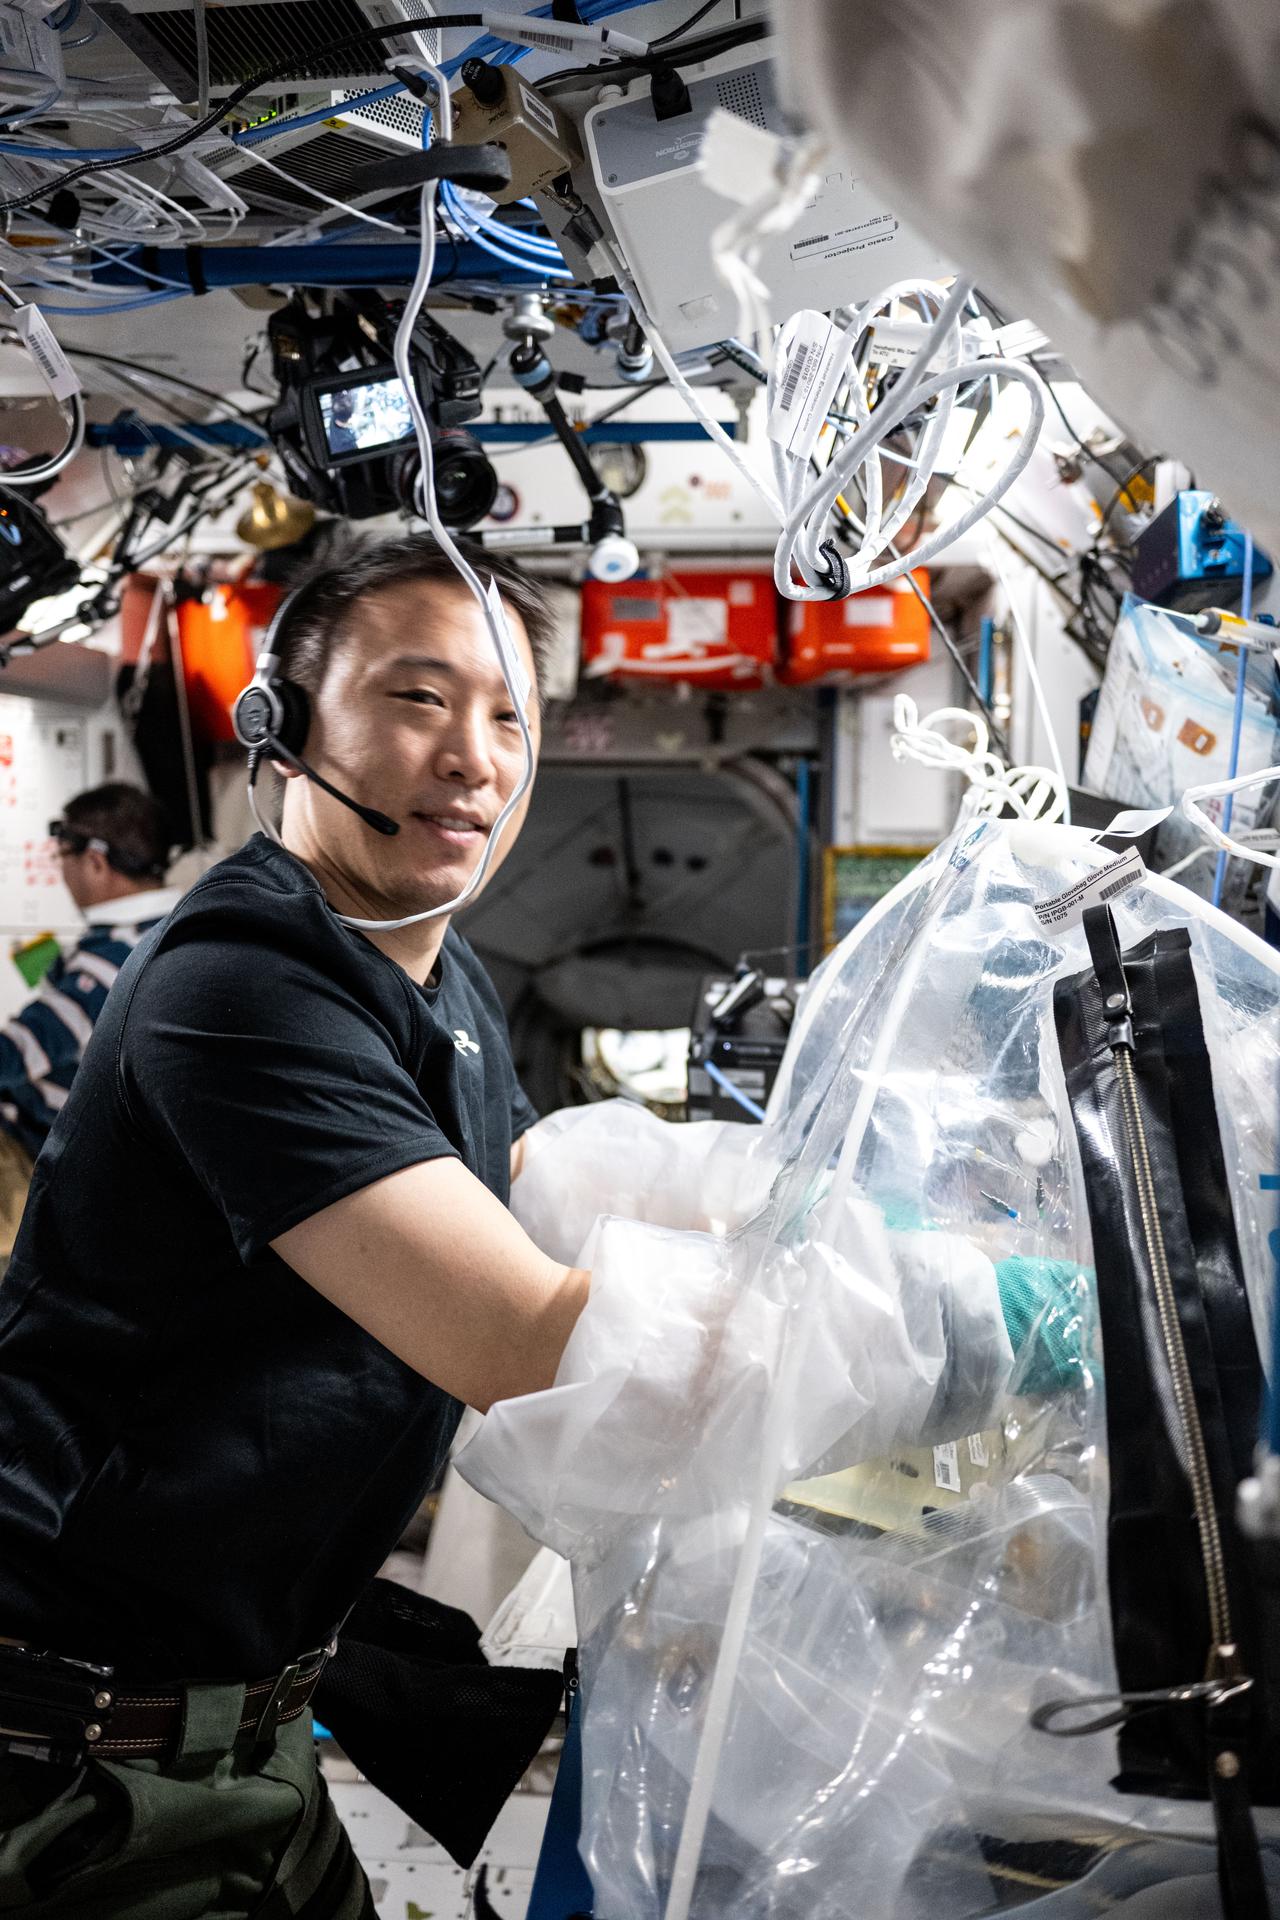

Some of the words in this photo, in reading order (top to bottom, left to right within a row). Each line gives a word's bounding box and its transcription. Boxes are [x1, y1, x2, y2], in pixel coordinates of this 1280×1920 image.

[868, 236, 894, 246] Casio
[824, 244, 865, 259] Projector
[811, 381, 824, 412] Extension
[1034, 898, 1061, 911] Portable
[1061, 881, 1087, 900] Glovebag
[1087, 870, 1103, 883] Glove
[1103, 856, 1127, 872] Medium
[1038, 912, 1050, 920] P/N
[1051, 894, 1084, 917] IPGB-001-M
[1053, 912, 1068, 923] 1075
